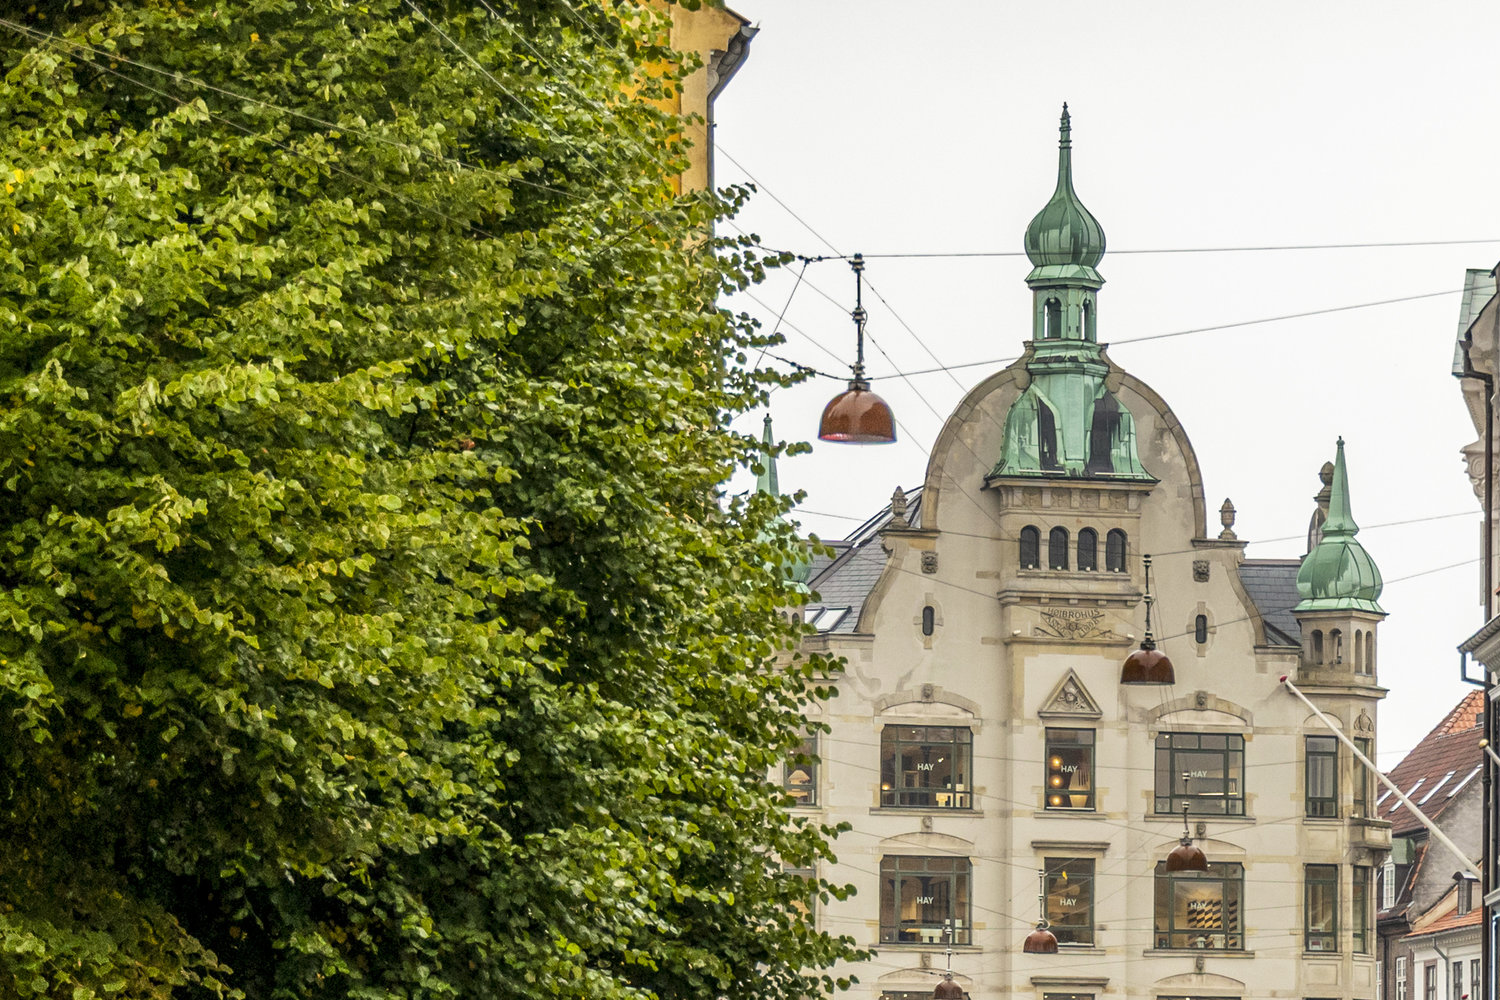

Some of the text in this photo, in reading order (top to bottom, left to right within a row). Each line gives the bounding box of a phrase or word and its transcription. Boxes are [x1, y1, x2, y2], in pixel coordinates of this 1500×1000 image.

[917, 763, 934, 771] HAY
[1061, 765, 1078, 773] HAY
[1190, 770, 1208, 778] HAY
[916, 896, 934, 904] HAY
[1060, 898, 1077, 906] HAY
